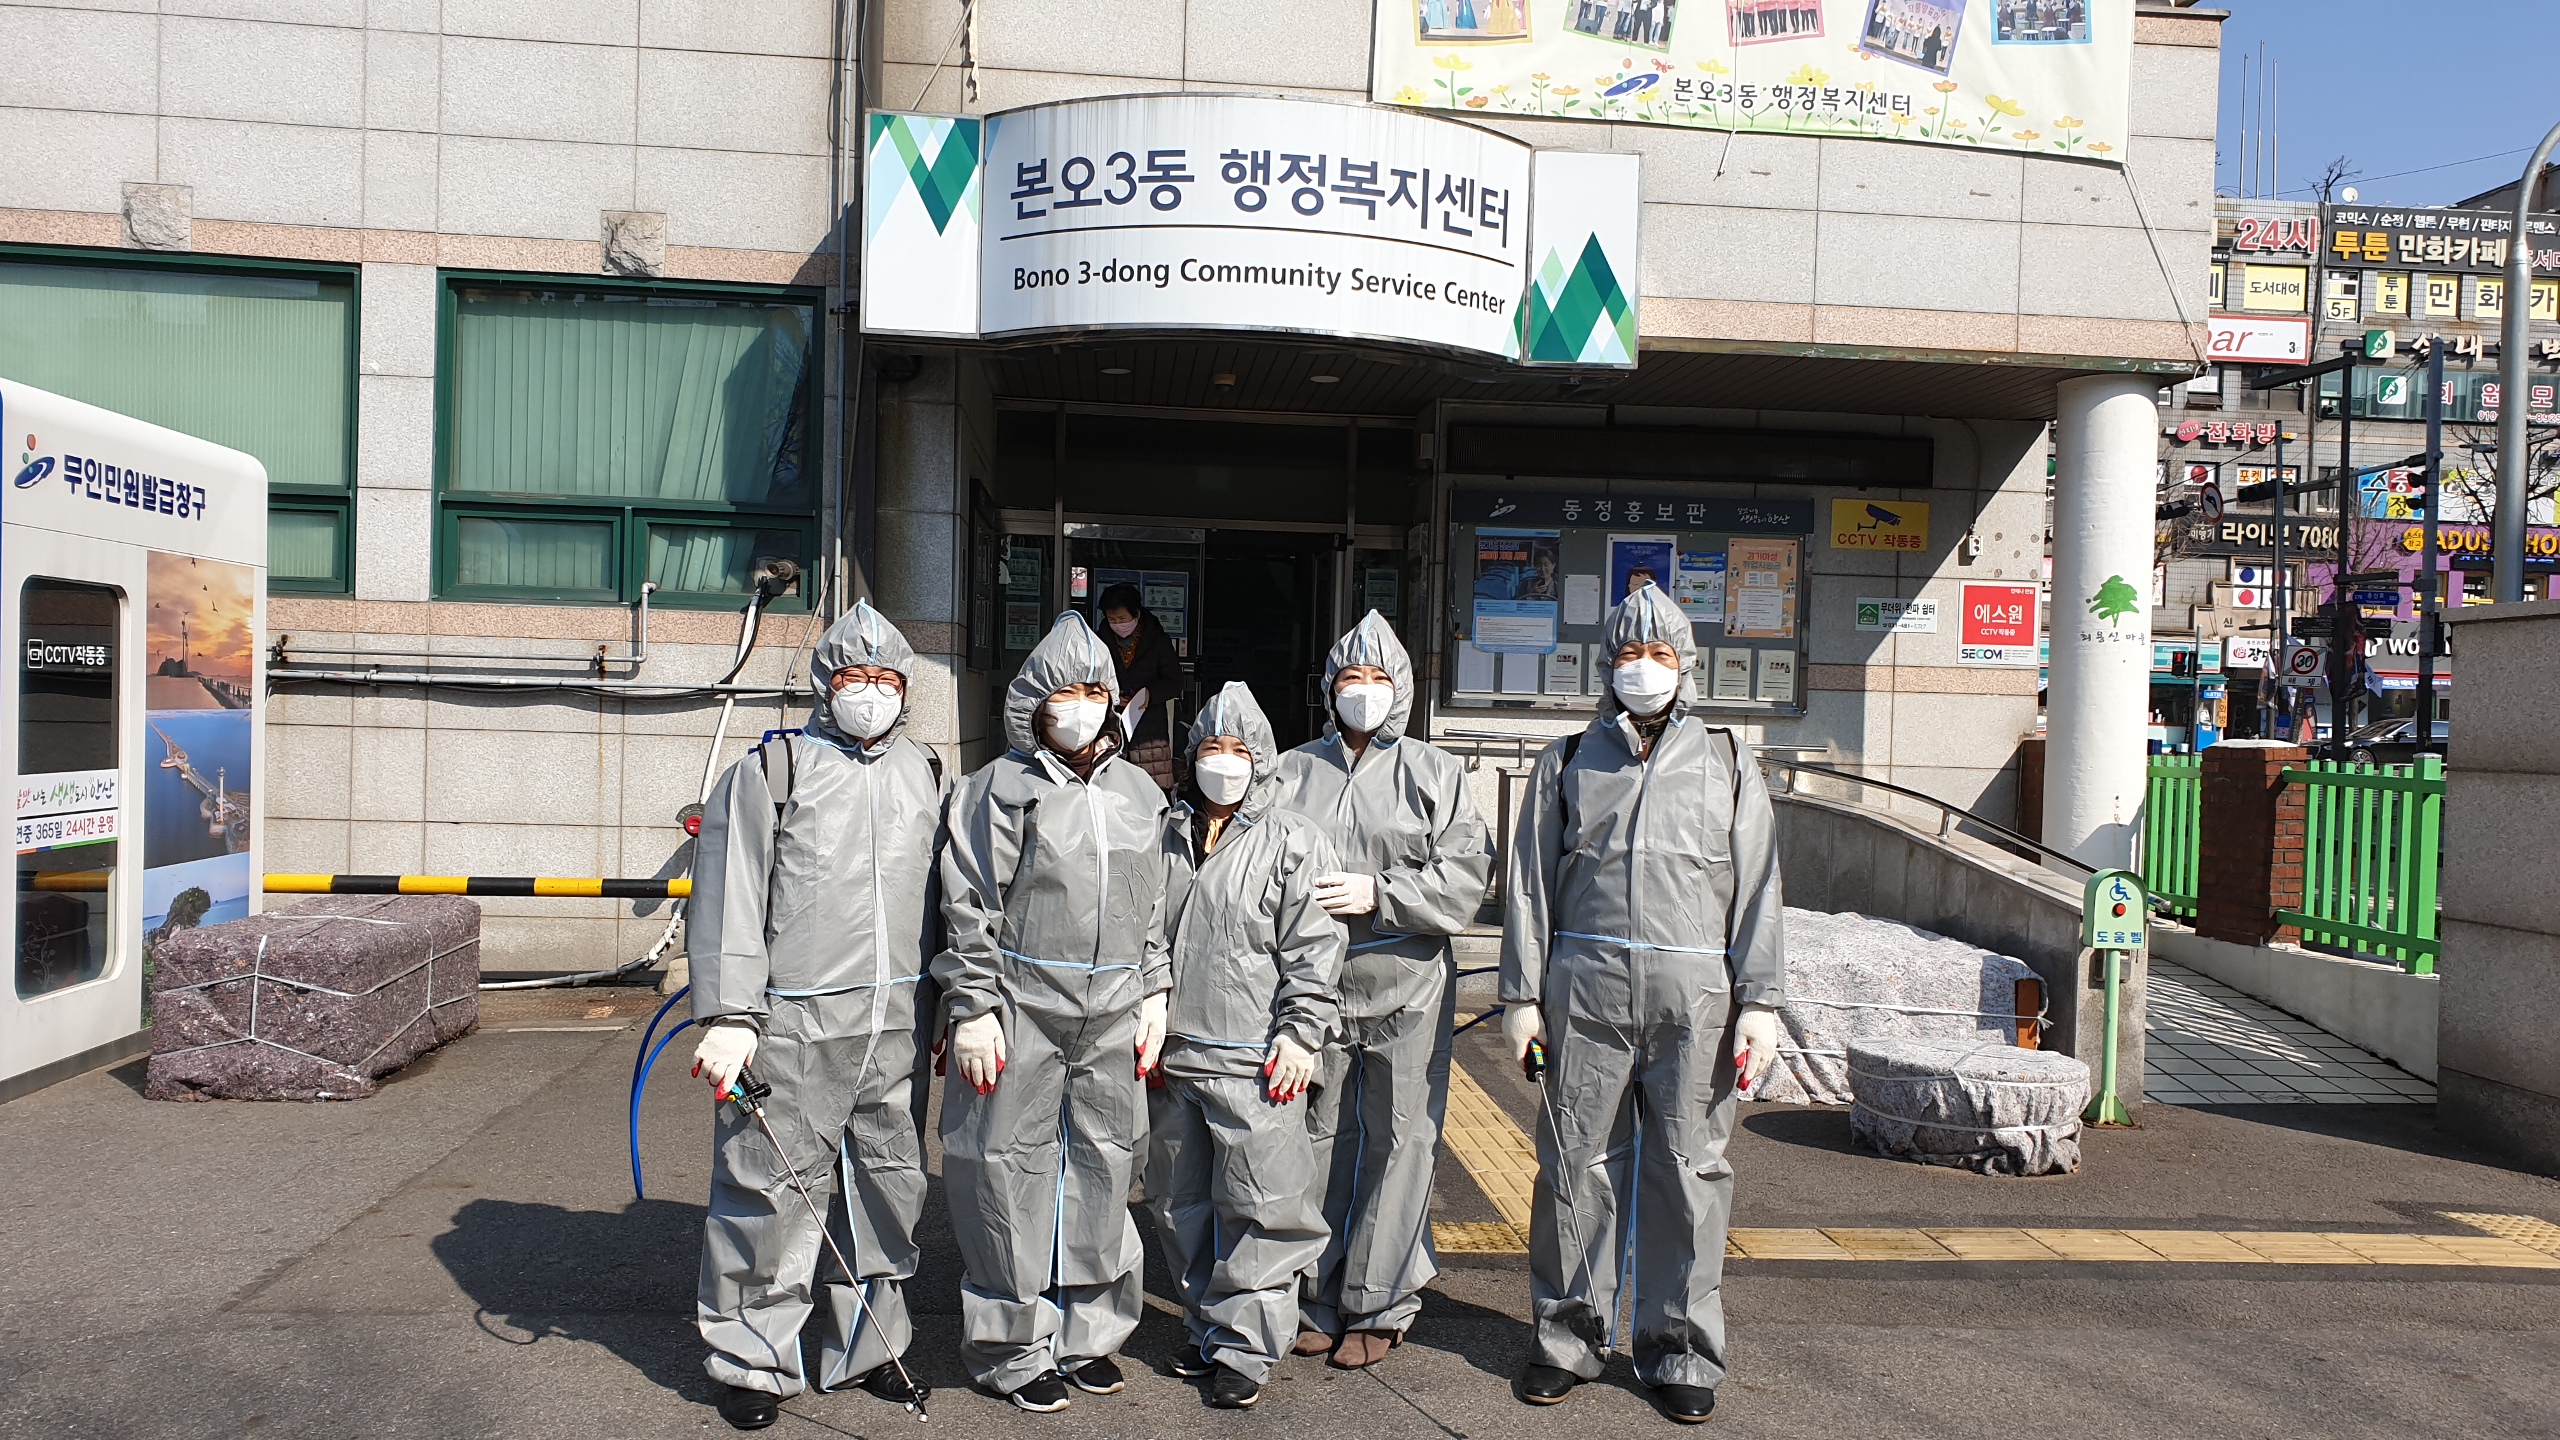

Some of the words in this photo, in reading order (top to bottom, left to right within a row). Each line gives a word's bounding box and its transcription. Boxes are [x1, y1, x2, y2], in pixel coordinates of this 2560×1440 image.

[1673, 77, 1760, 111] 본오3동
[1771, 83, 1914, 117] 행정복지센터
[1010, 149, 1195, 222] 본오3동
[1219, 148, 1510, 249] 행정복지센터
[2335, 211, 2370, 226] 코믹스
[2237, 217, 2318, 254] 24시
[2332, 230, 2390, 262] 투툰
[2398, 234, 2508, 268] 만화카페
[1013, 263, 1070, 292] Bono
[1077, 259, 1171, 290] 3-dong
[1180, 258, 1342, 295] Community
[1351, 267, 1436, 301] Service
[1444, 281, 1507, 316] Center
[2249, 281, 2300, 297] 도서대여
[2430, 282, 2453, 308] 만
[2330, 302, 2351, 318] 5F
[2530, 287, 2555, 313] 카
[2207, 328, 2253, 352] ar
[63, 453, 206, 521] 무인민원발급창구
[2239, 469, 2263, 483] 포켓
[1561, 499, 1707, 525] 동정홍보판
[1837, 533, 1878, 546] CCTV
[1884, 533, 1922, 549] 작동중
[2525, 533, 2560, 555] HO
[1880, 602, 1920, 615] 무더위·한파
[1974, 603, 2023, 625] 에스원
[1980, 628, 1998, 636] CCTV
[44, 645, 106, 666] CCTV작동중
[1961, 648, 2003, 660] SECOM
[2296, 654, 2314, 668] 30
[32, 788, 47, 806] 나는
[89, 778, 115, 801] 안산
[35, 820, 63, 840] 365일
[66, 817, 95, 837] 24시간
[97, 814, 114, 834] 운영
[2096, 930, 2142, 944] 도움벨
